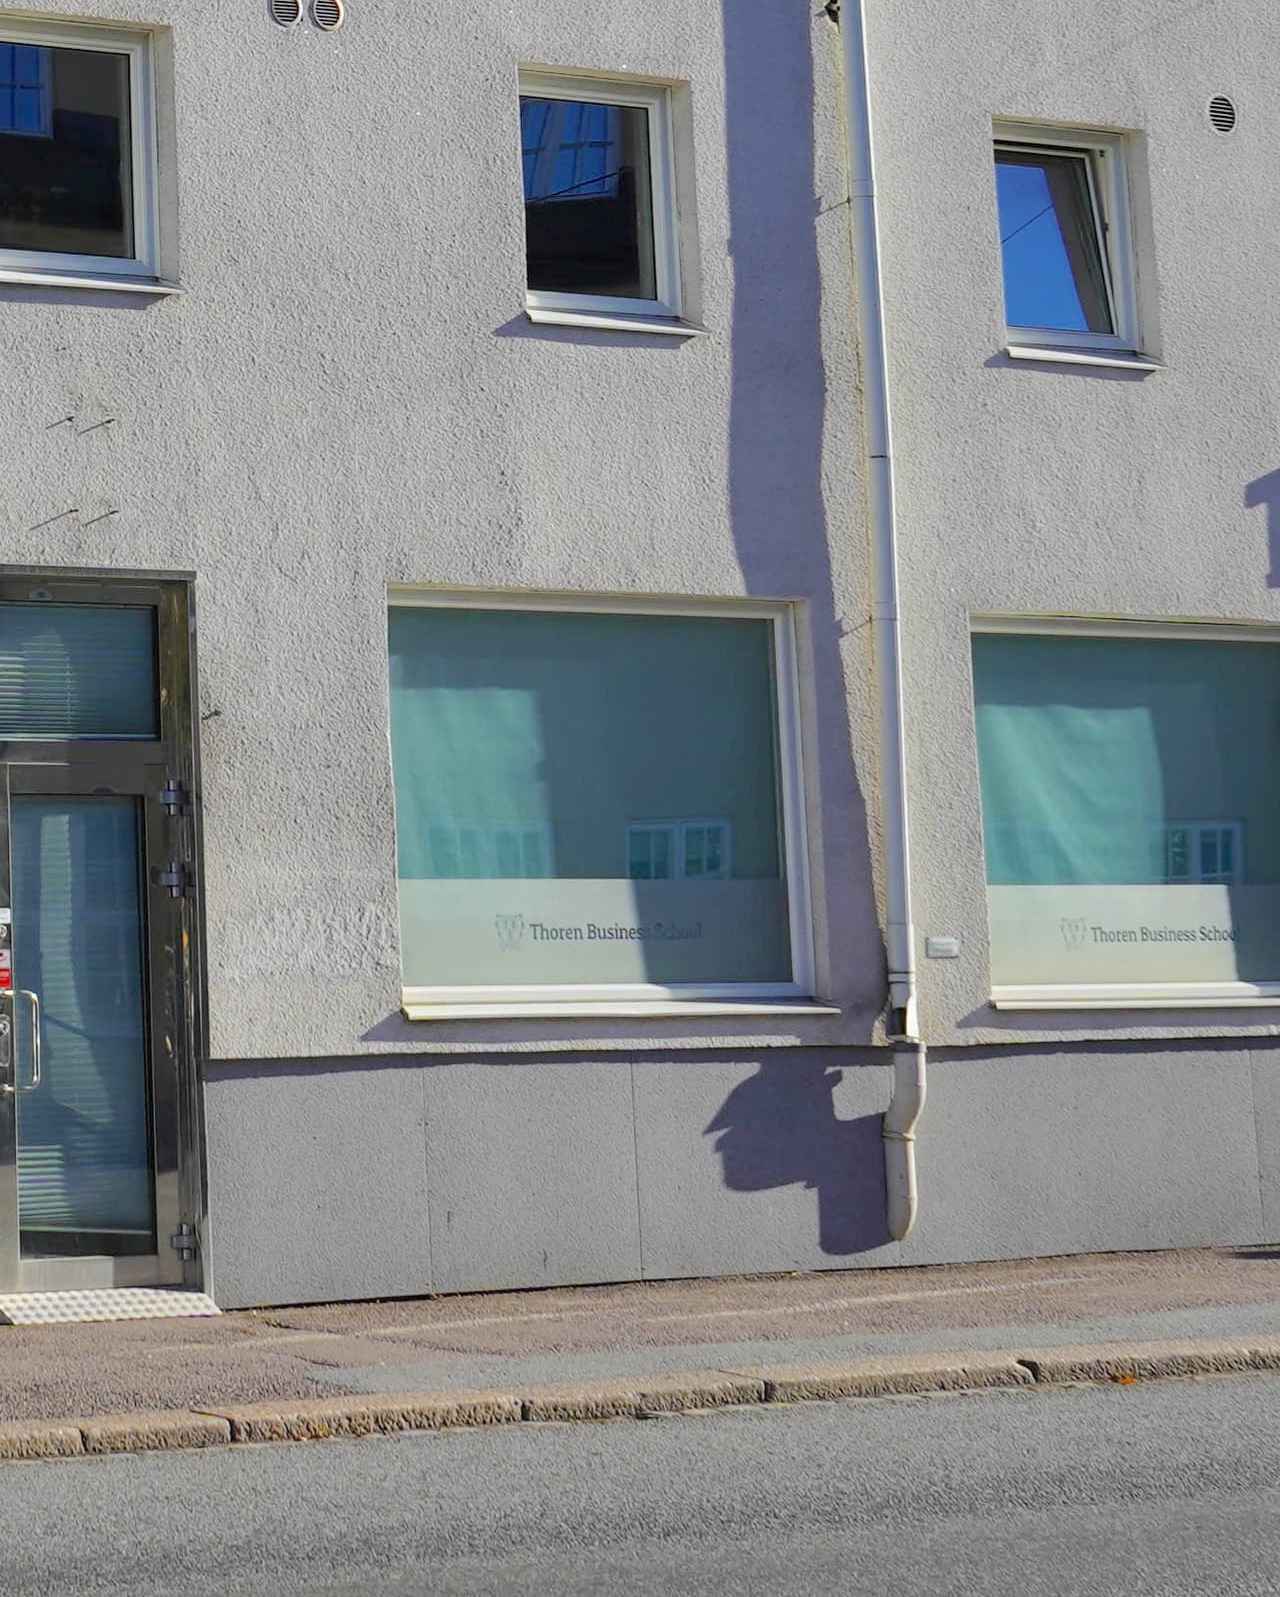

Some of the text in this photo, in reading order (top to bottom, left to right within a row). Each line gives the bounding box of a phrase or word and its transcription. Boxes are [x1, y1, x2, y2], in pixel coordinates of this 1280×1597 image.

[530, 923, 583, 941] Thoren
[1091, 925, 1137, 943] Thoren
[1141, 925, 1196, 942] Business
